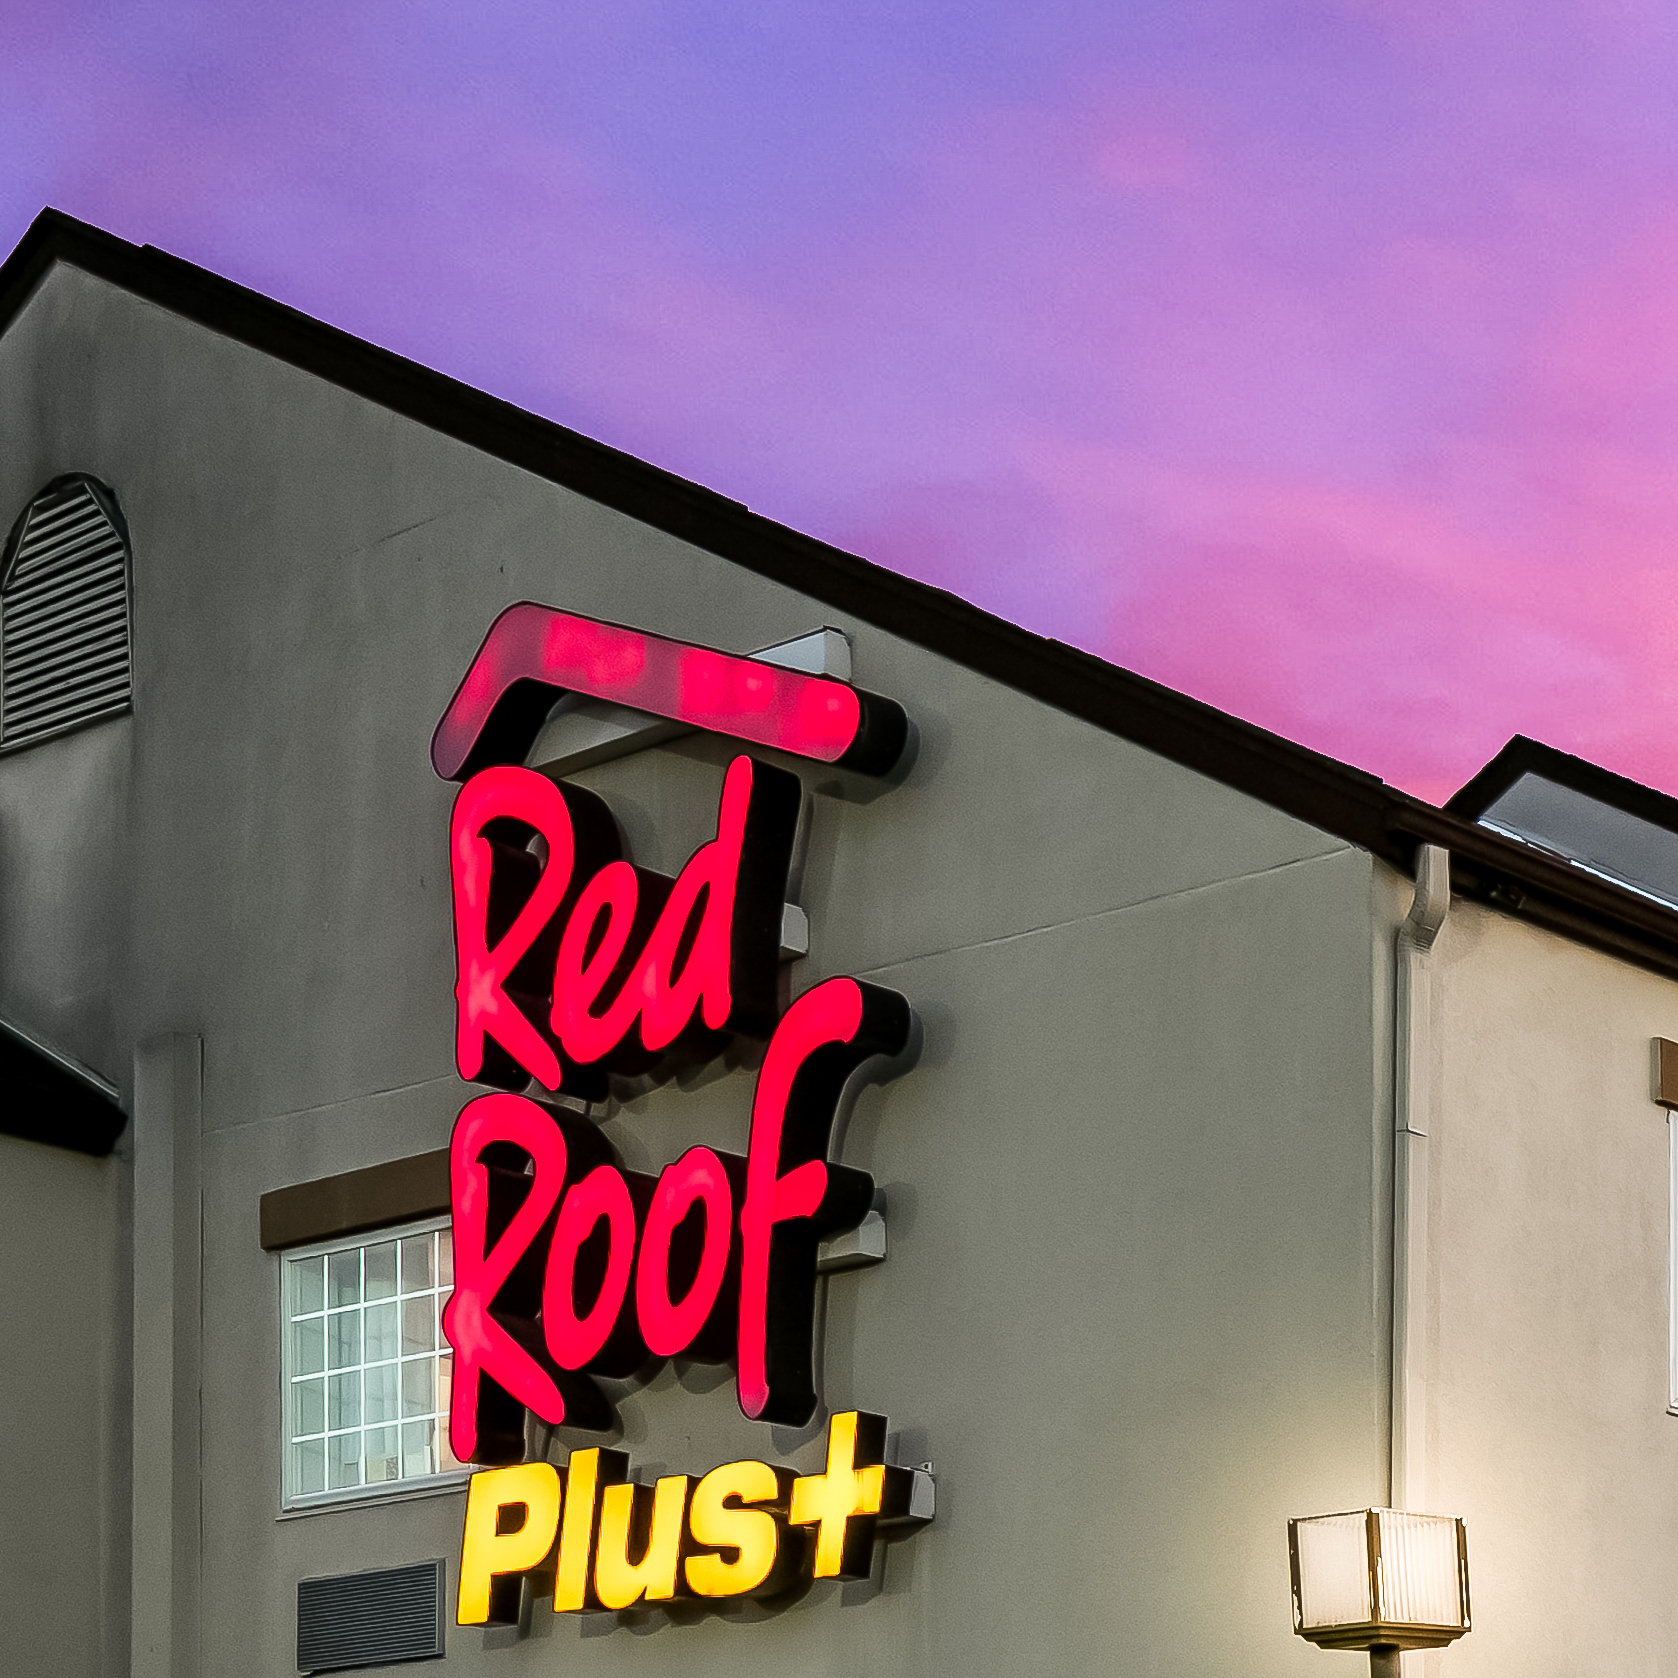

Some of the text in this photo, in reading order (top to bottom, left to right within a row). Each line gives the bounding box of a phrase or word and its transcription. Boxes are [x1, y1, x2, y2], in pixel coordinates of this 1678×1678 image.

[449, 755, 756, 1092] Red
[442, 975, 863, 1463] Roof
[455, 1410, 886, 1626] Plus+
